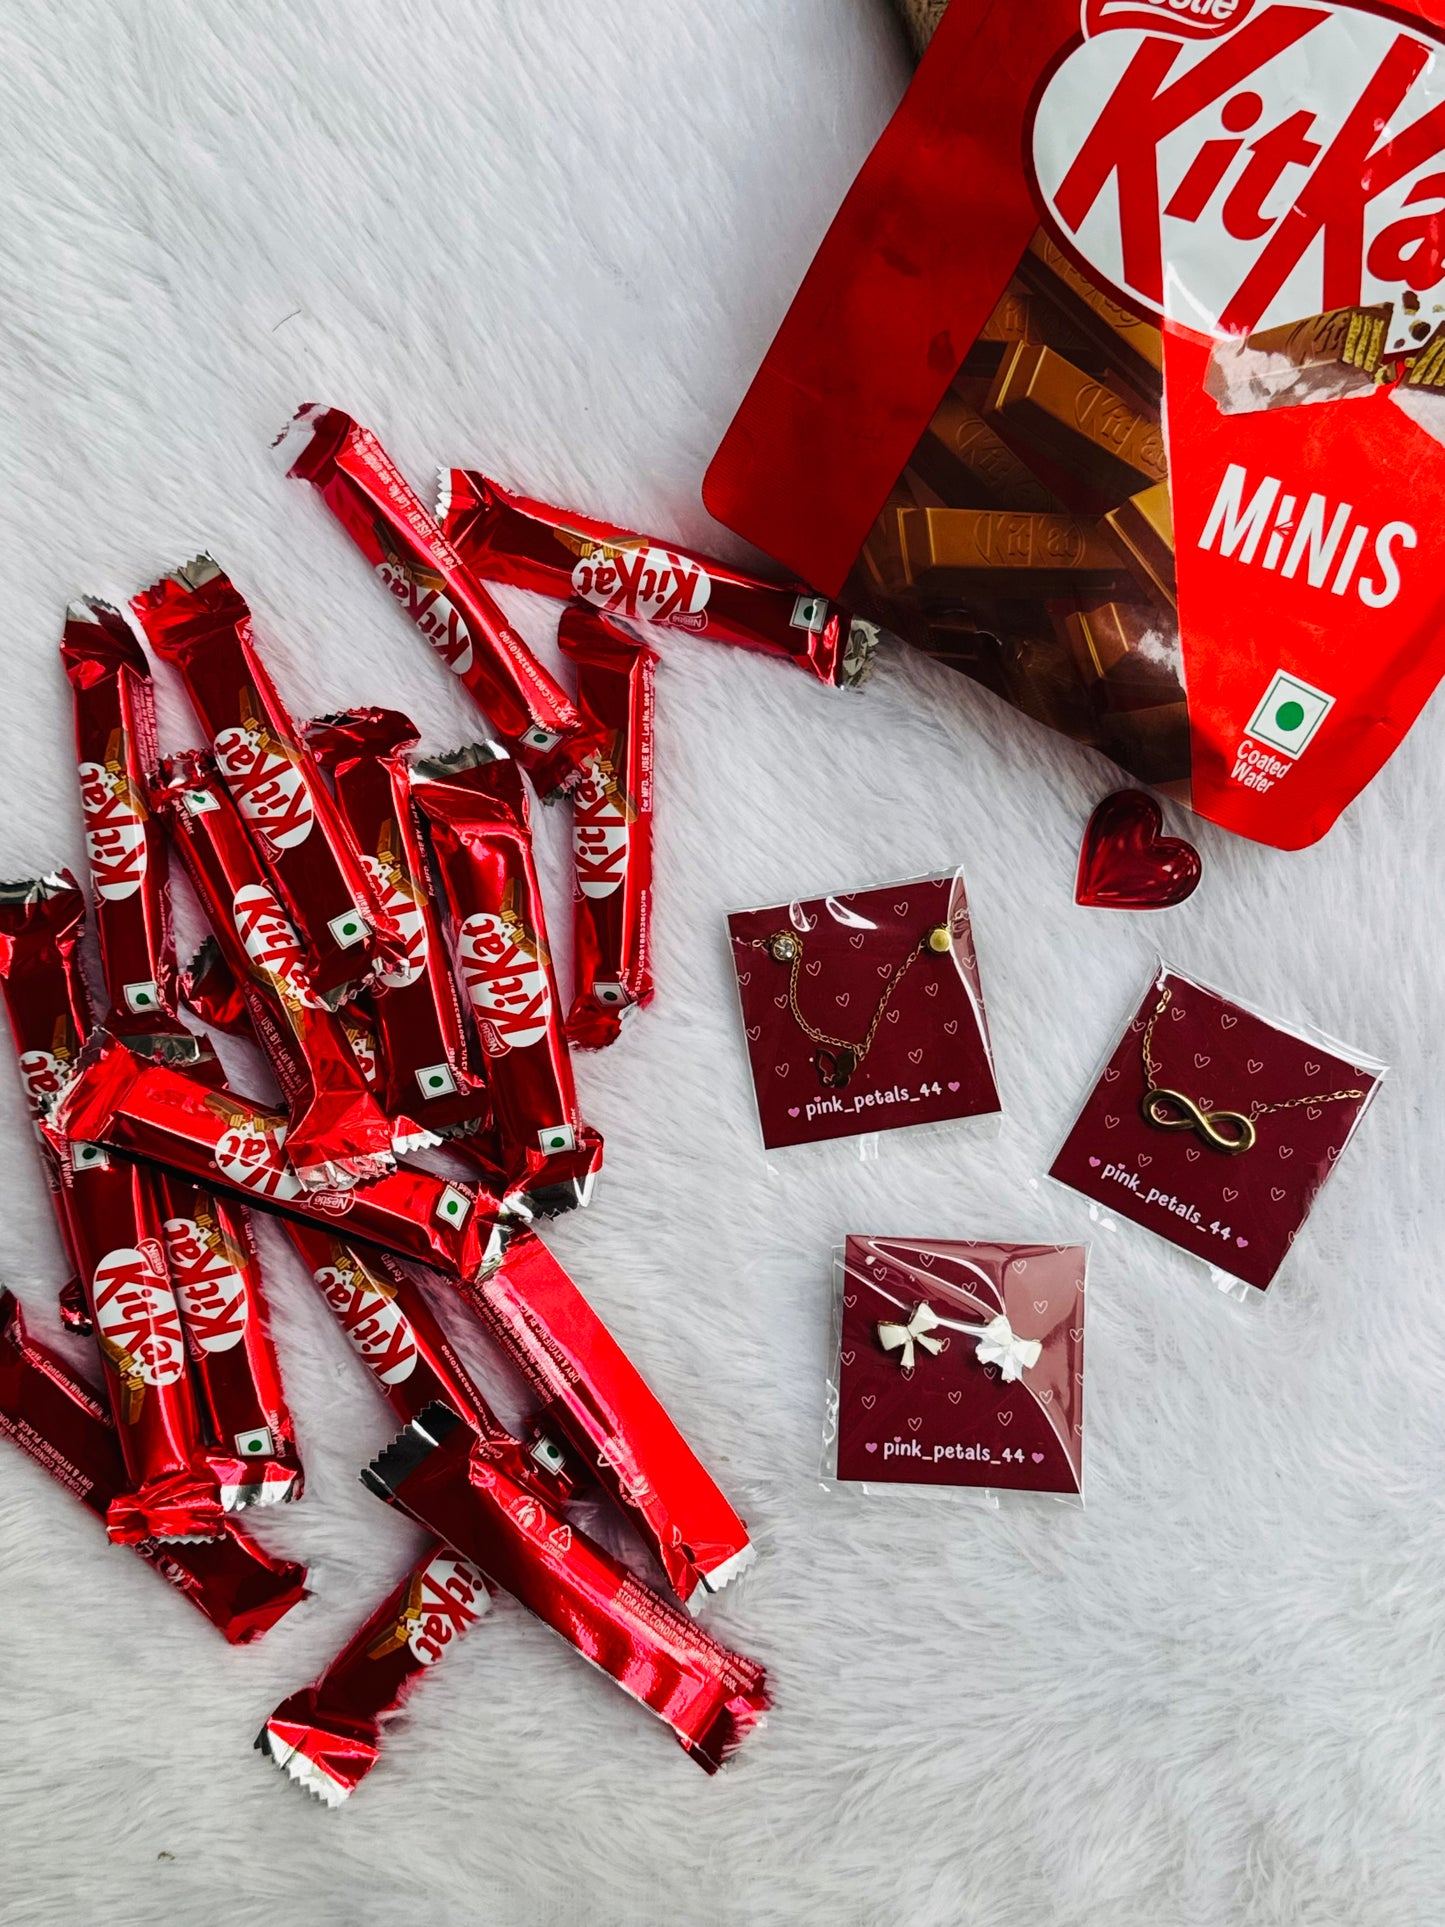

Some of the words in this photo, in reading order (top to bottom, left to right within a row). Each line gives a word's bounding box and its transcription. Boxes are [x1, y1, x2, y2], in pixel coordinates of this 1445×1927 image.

[1053, 5, 1445, 335] KitKa
[392, 491, 411, 510] Lot
[404, 506, 422, 525] BY
[412, 517, 433, 540] USE
[1198, 463, 1417, 608] MINIS
[439, 553, 458, 572] For
[578, 547, 700, 620] KitKat
[381, 567, 470, 668] KitKat
[640, 754, 649, 771] USE
[1230, 759, 1274, 794] Wafer
[1236, 739, 1292, 779] Coated
[216, 733, 313, 841] KitKat
[640, 798, 650, 812] For
[80, 768, 146, 887] KitKat
[462, 918, 550, 1034] KitKat
[258, 1015, 276, 1036] USE
[267, 1031, 283, 1047] BY
[806, 1079, 942, 1122] pink_petals_44
[58, 1161, 79, 1189] Wafer
[1101, 1161, 1232, 1242] pink_petals_44
[166, 1223, 247, 1341] KitKat
[95, 1261, 182, 1380] KitKat
[318, 1271, 416, 1377] KitKat
[41, 1358, 72, 1389] Contains
[563, 1363, 582, 1384] DRY
[38, 1438, 75, 1473] HYGIENIC
[884, 1436, 1025, 1467] pink_petals_44
[51, 1463, 89, 1498] STORAGE
[75, 1472, 95, 1490] DRY
[415, 1552, 484, 1662] itKat
[614, 1586, 653, 1621] STORAGE
